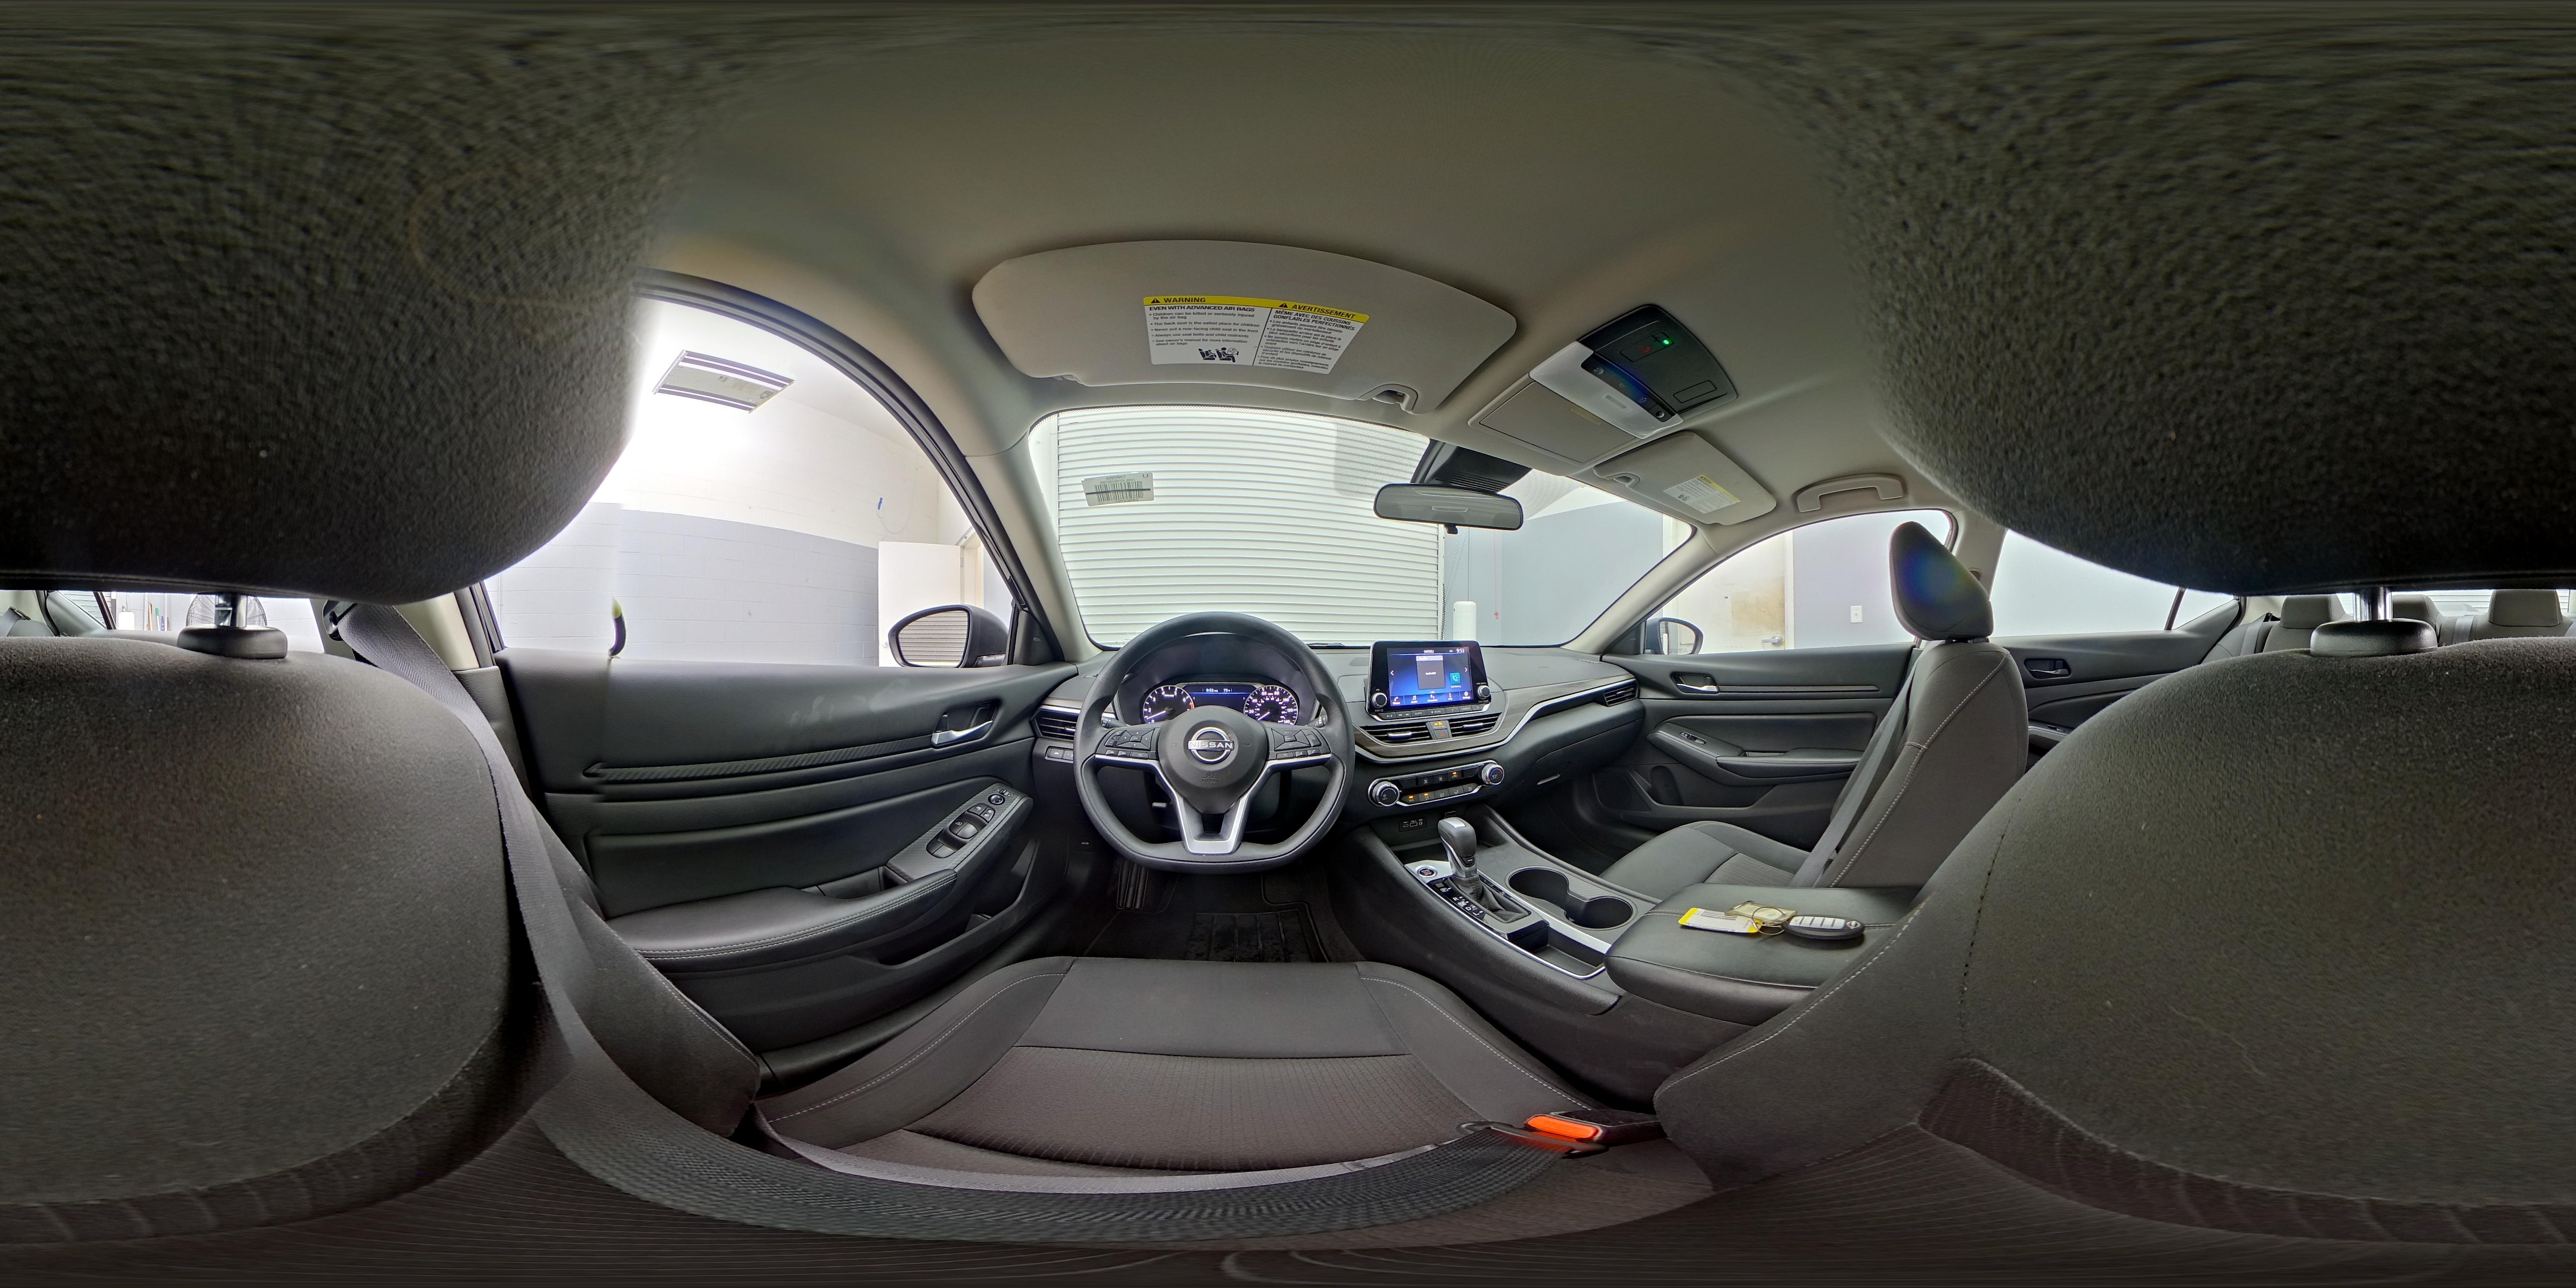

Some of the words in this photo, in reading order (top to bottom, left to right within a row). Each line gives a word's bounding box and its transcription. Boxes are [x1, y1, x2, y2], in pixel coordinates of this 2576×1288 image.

[1292, 304, 1356, 319] AVERTISSEMENT
[1312, 319, 1355, 331] PERFECTIONNÉS
[1324, 317, 1351, 325] COUSSINS
